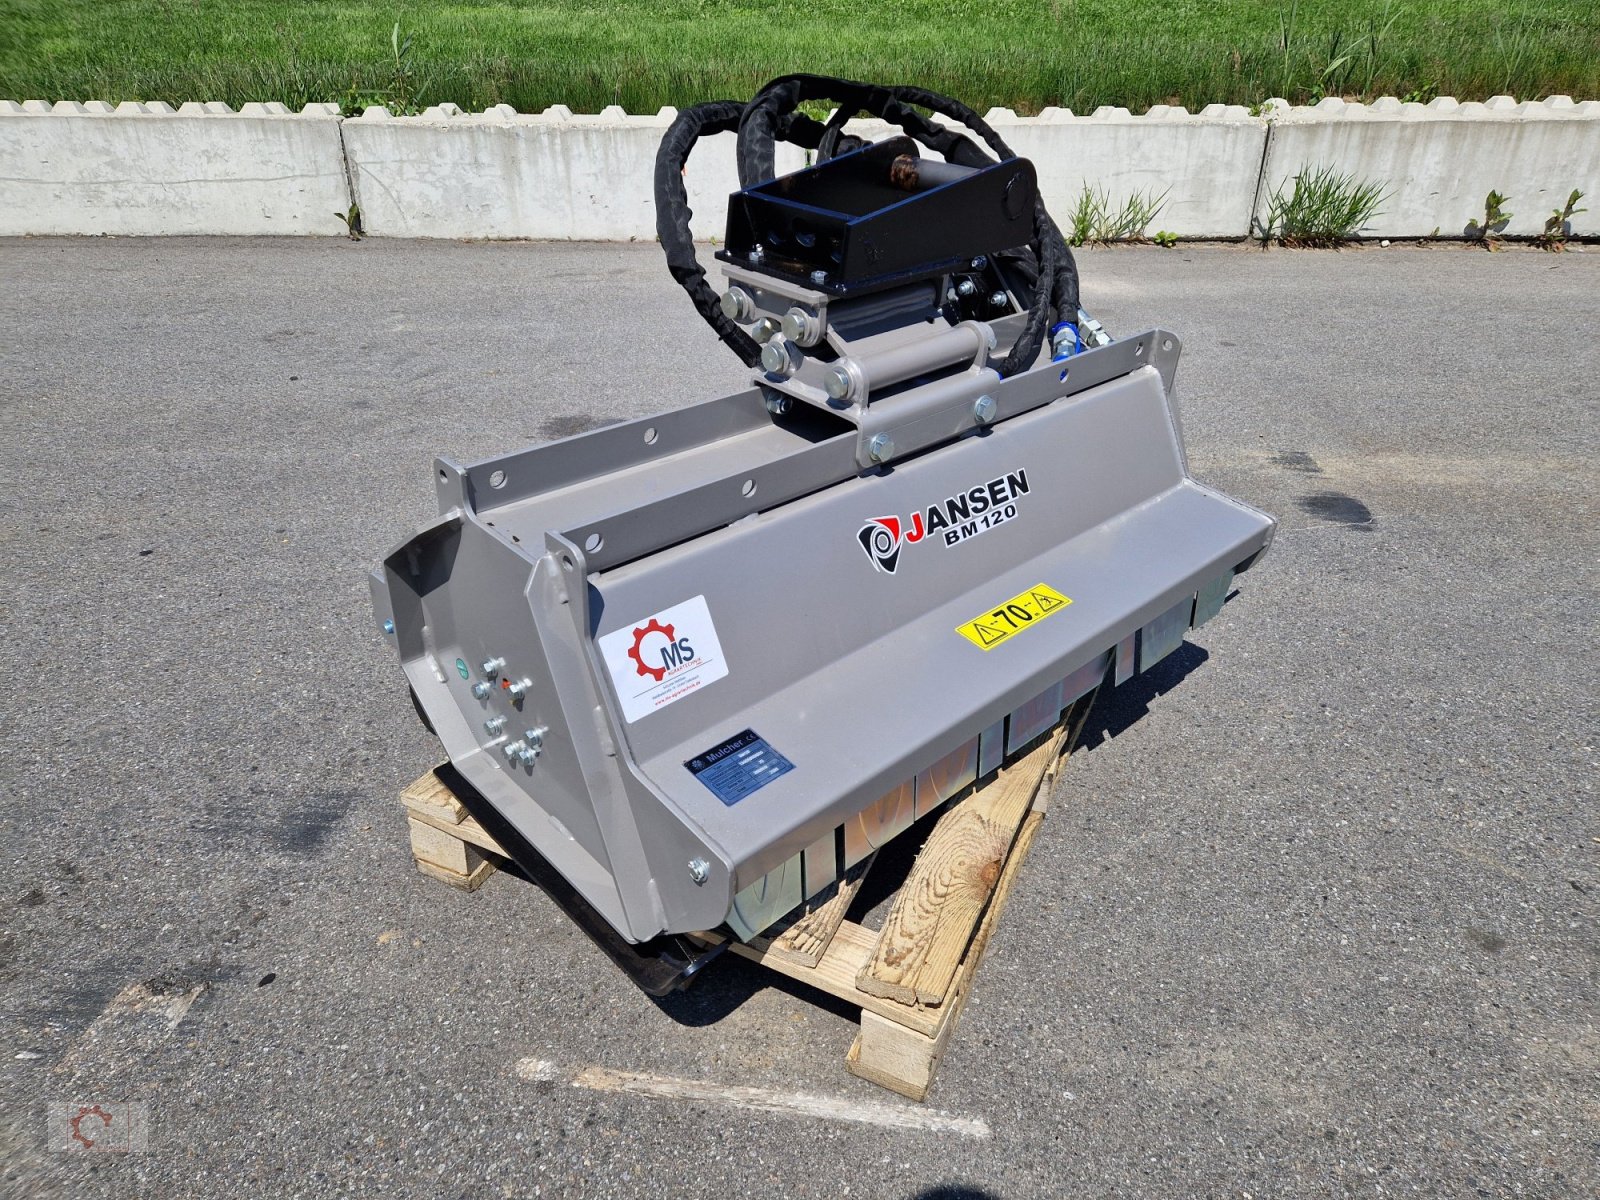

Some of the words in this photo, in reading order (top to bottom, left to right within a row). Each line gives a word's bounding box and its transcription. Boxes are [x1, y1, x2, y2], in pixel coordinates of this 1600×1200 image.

[905, 469, 1030, 543] JANSEN
[944, 521, 978, 546] BM
[981, 504, 1016, 529] 120
[992, 604, 1033, 628] 70
[660, 637, 695, 671] MS
[706, 739, 744, 762] Mulcher
